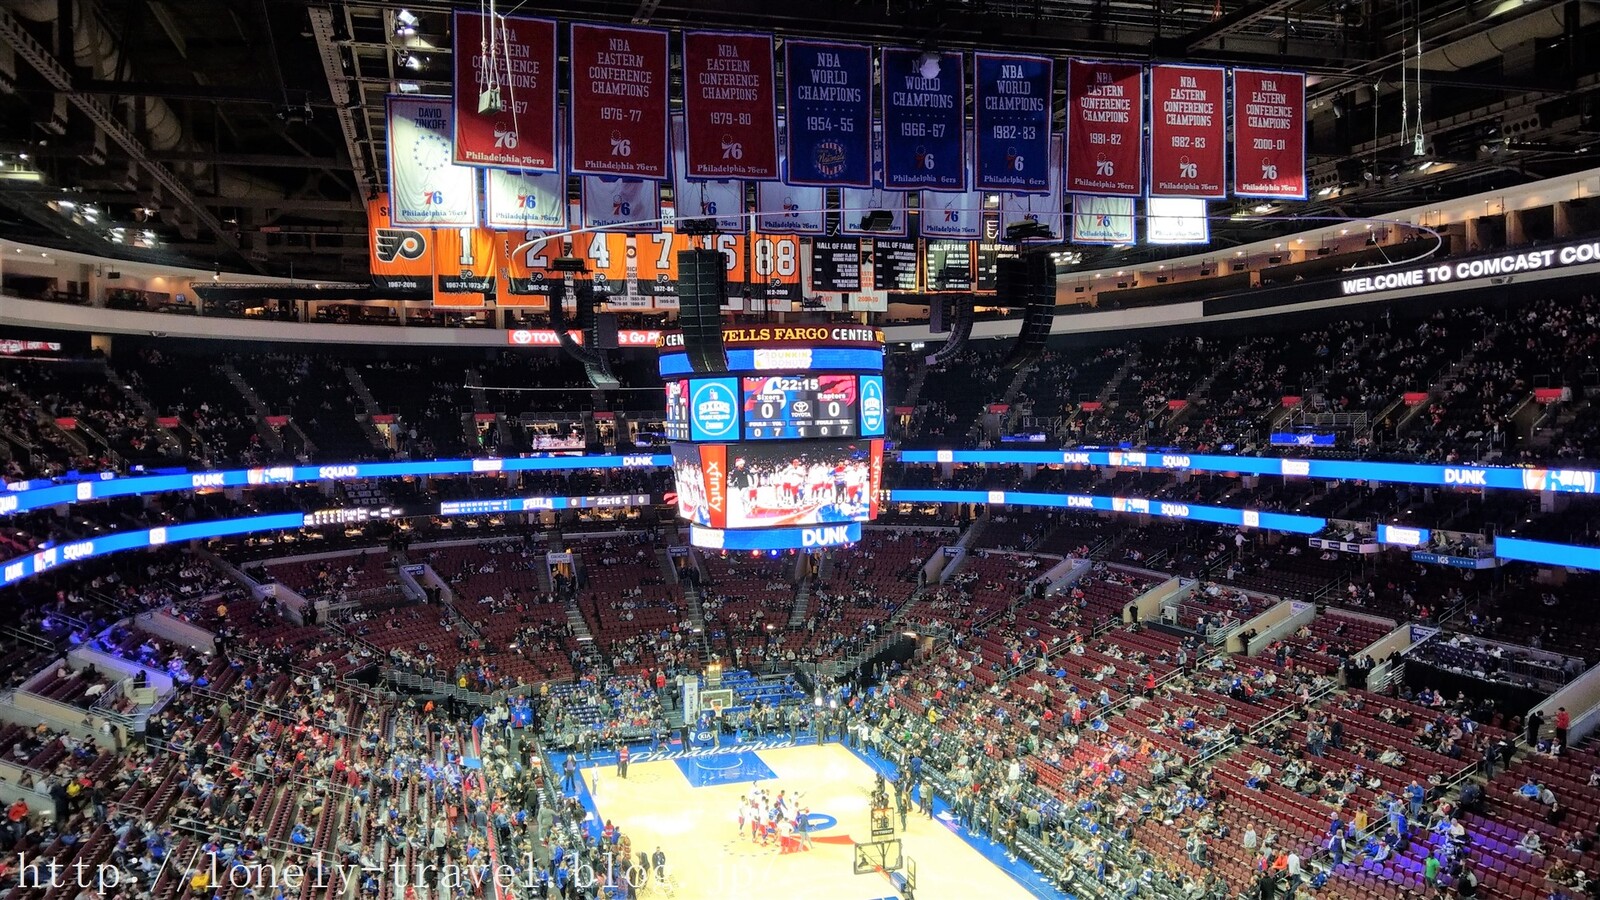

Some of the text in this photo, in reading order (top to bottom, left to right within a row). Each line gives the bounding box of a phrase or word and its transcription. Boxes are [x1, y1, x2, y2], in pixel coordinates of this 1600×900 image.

[494, 28, 516, 42] NBA
[609, 38, 630, 51] NBA
[718, 45, 738, 57] NBA
[472, 56, 539, 74] CONFERENCE
[597, 52, 644, 68] EASTERN
[707, 58, 750, 73] EASTERN
[817, 52, 841, 68] NBA
[589, 67, 652, 83] CONFERENCE
[811, 69, 848, 85] WORLD
[1002, 65, 1024, 78] NBA
[1097, 72, 1113, 83] NBA
[700, 73, 759, 87] CONFERENCE
[905, 76, 940, 91] WORLD
[1180, 76, 1197, 88] NBA
[1261, 80, 1277, 92] NBA
[592, 81, 649, 98] CHAMPIONS
[702, 87, 757, 100] CHAMPIONS
[798, 86, 861, 102] CHAMPIONS
[997, 81, 1030, 95] WORLD
[1087, 85, 1123, 97] EASTERN
[1170, 89, 1206, 101] EASTERN
[893, 92, 953, 108] CHAMPIONS
[985, 97, 1043, 111] CHAMPIONS
[1081, 97, 1130, 110] CONFERENCE
[1252, 92, 1286, 104] EASTERN
[418, 107, 442, 118] DAVID
[601, 107, 642, 122] 1976-77
[1164, 102, 1214, 114] CONFERENCE
[1246, 104, 1292, 118] CONFERENCE
[710, 112, 751, 125] 1979-80
[1082, 110, 1129, 123] CHAMPIONS
[1166, 114, 1212, 126] CHAMPIONS
[1248, 116, 1291, 129] CHAMPIONS
[414, 118, 446, 130] ZINKOFF
[807, 116, 853, 132] 1954-55
[902, 122, 945, 138] 1966-67
[494, 130, 517, 148] 76
[993, 126, 1036, 140] 1982-83
[1090, 133, 1121, 145] 1981-82
[611, 139, 631, 157] 76
[1171, 136, 1206, 149] 1982-83
[1253, 138, 1286, 150] 2000-01
[466, 151, 544, 165] Philadelphia 76ers
[722, 142, 742, 160] 76
[585, 161, 658, 171] Philadelphia 76ers
[697, 164, 746, 173] Philadelphia
[1096, 161, 1114, 176] 76
[1180, 163, 1197, 179] 76
[1262, 164, 1278, 180] 76
[893, 175, 936, 183] Philadelphia
[984, 175, 1025, 184] Philadelphia
[1074, 178, 1134, 190] Philadelphia 76ers
[1159, 182, 1218, 191] Philadelphia 76ers
[1242, 183, 1297, 192] Philadelphia 76ers
[424, 191, 443, 205] 76
[517, 194, 536, 209] 76
[401, 209, 447, 218] Philadelphia
[496, 212, 539, 221] Philadelphia
[612, 203, 630, 216] 76
[944, 210, 959, 222] 76
[764, 221, 801, 229] Philadelphia
[1096, 214, 1110, 227] 76
[926, 225, 960, 233] Philadelphia
[460, 228, 474, 265] 1
[525, 230, 548, 268] 2
[588, 233, 610, 268] 4
[652, 232, 673, 269] 7
[755, 238, 796, 276] 88
[1343, 269, 1423, 294] WELCOME
[1427, 265, 1451, 283] TO
[1455, 250, 1554, 279] COMCAST
[532, 332, 580, 342] TOYA
[630, 332, 646, 342] Go
[666, 334, 684, 346] CEN
[774, 328, 828, 341] FARGO
[832, 329, 873, 341] CENTER
[781, 379, 819, 390] 22:15
[761, 402, 840, 418] 0 0
[754, 426, 848, 437] 0 7 1 0 7
[623, 456, 653, 466] DUNK
[1064, 453, 1190, 468] DUNK SQUAD
[193, 466, 358, 486] DUNK SQUAD
[871, 455, 881, 504] xfinity
[1445, 469, 1486, 485] DUNK
[706, 461, 723, 512] xfinity
[1068, 496, 1189, 516] DUNK SQUAD
[802, 526, 849, 545] DUNK
[64, 542, 94, 560] SQUAD
